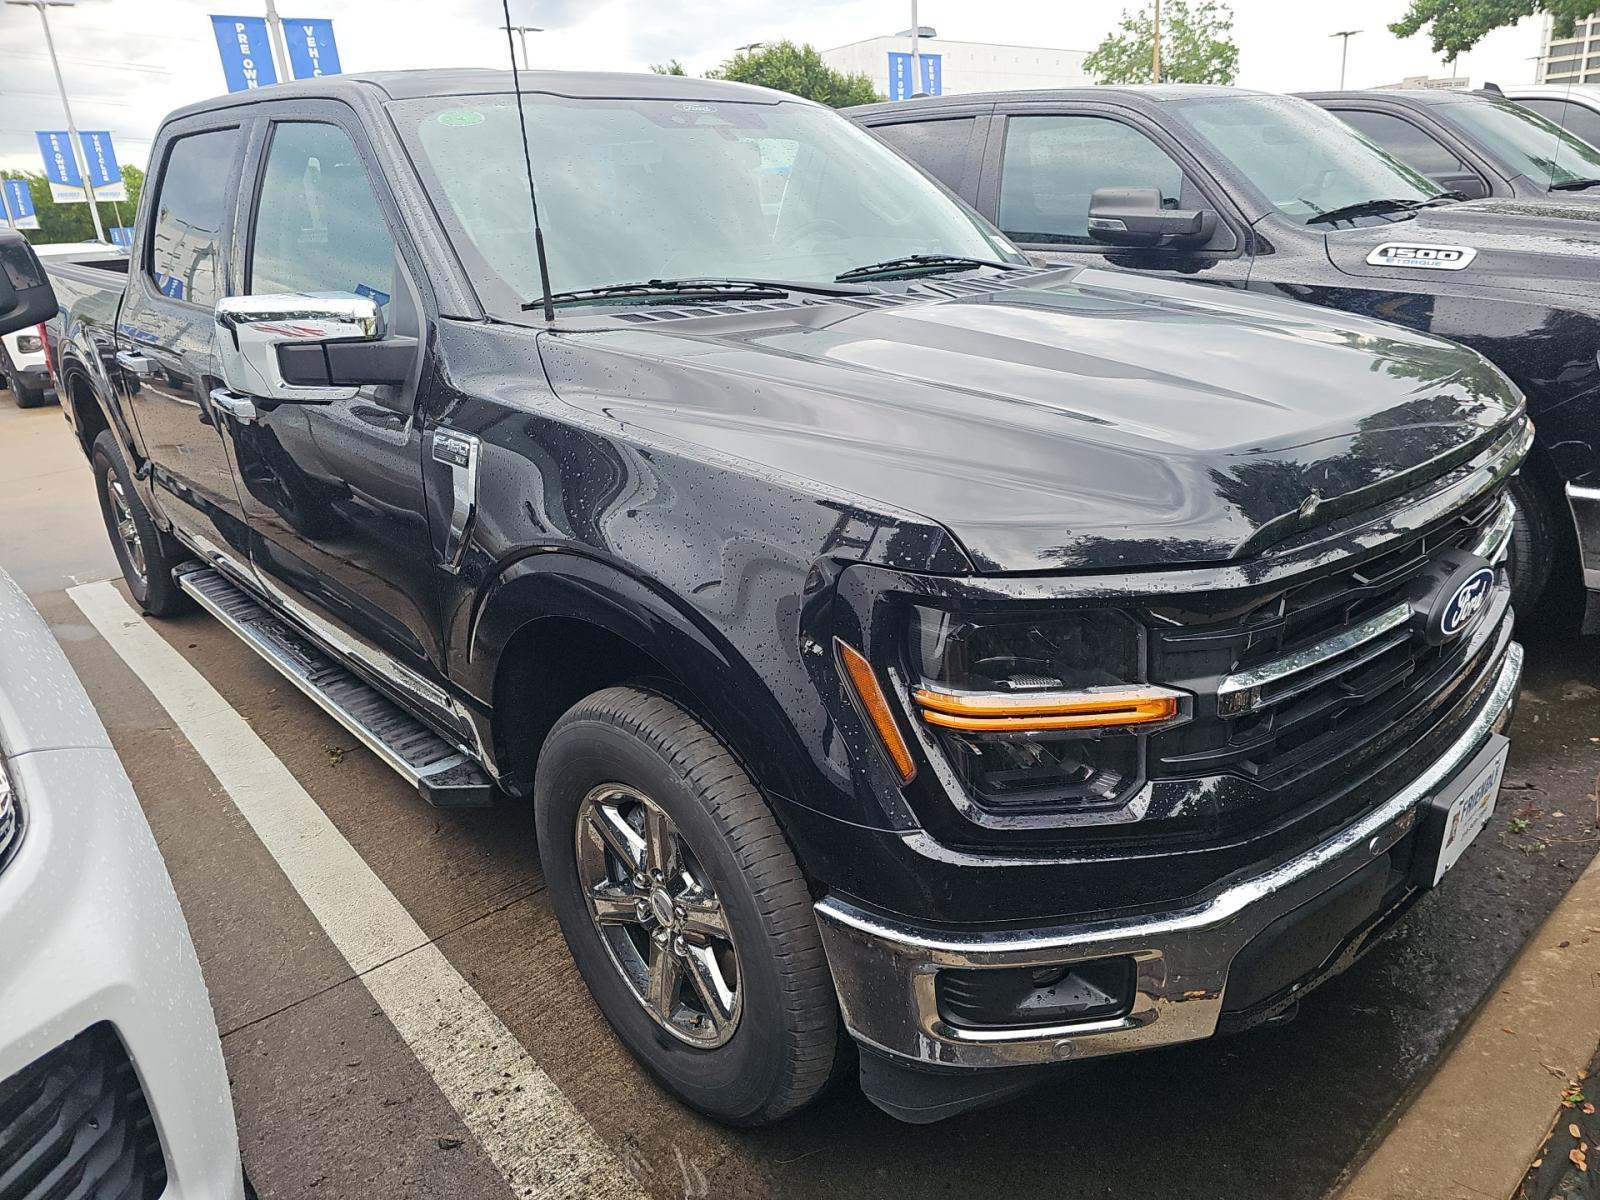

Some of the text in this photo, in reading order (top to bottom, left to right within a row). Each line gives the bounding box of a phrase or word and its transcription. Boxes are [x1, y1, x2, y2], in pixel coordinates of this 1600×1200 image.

[234, 22, 250, 54] PRE
[1384, 247, 1460, 260] 1500
[1451, 578, 1488, 628] Ford
